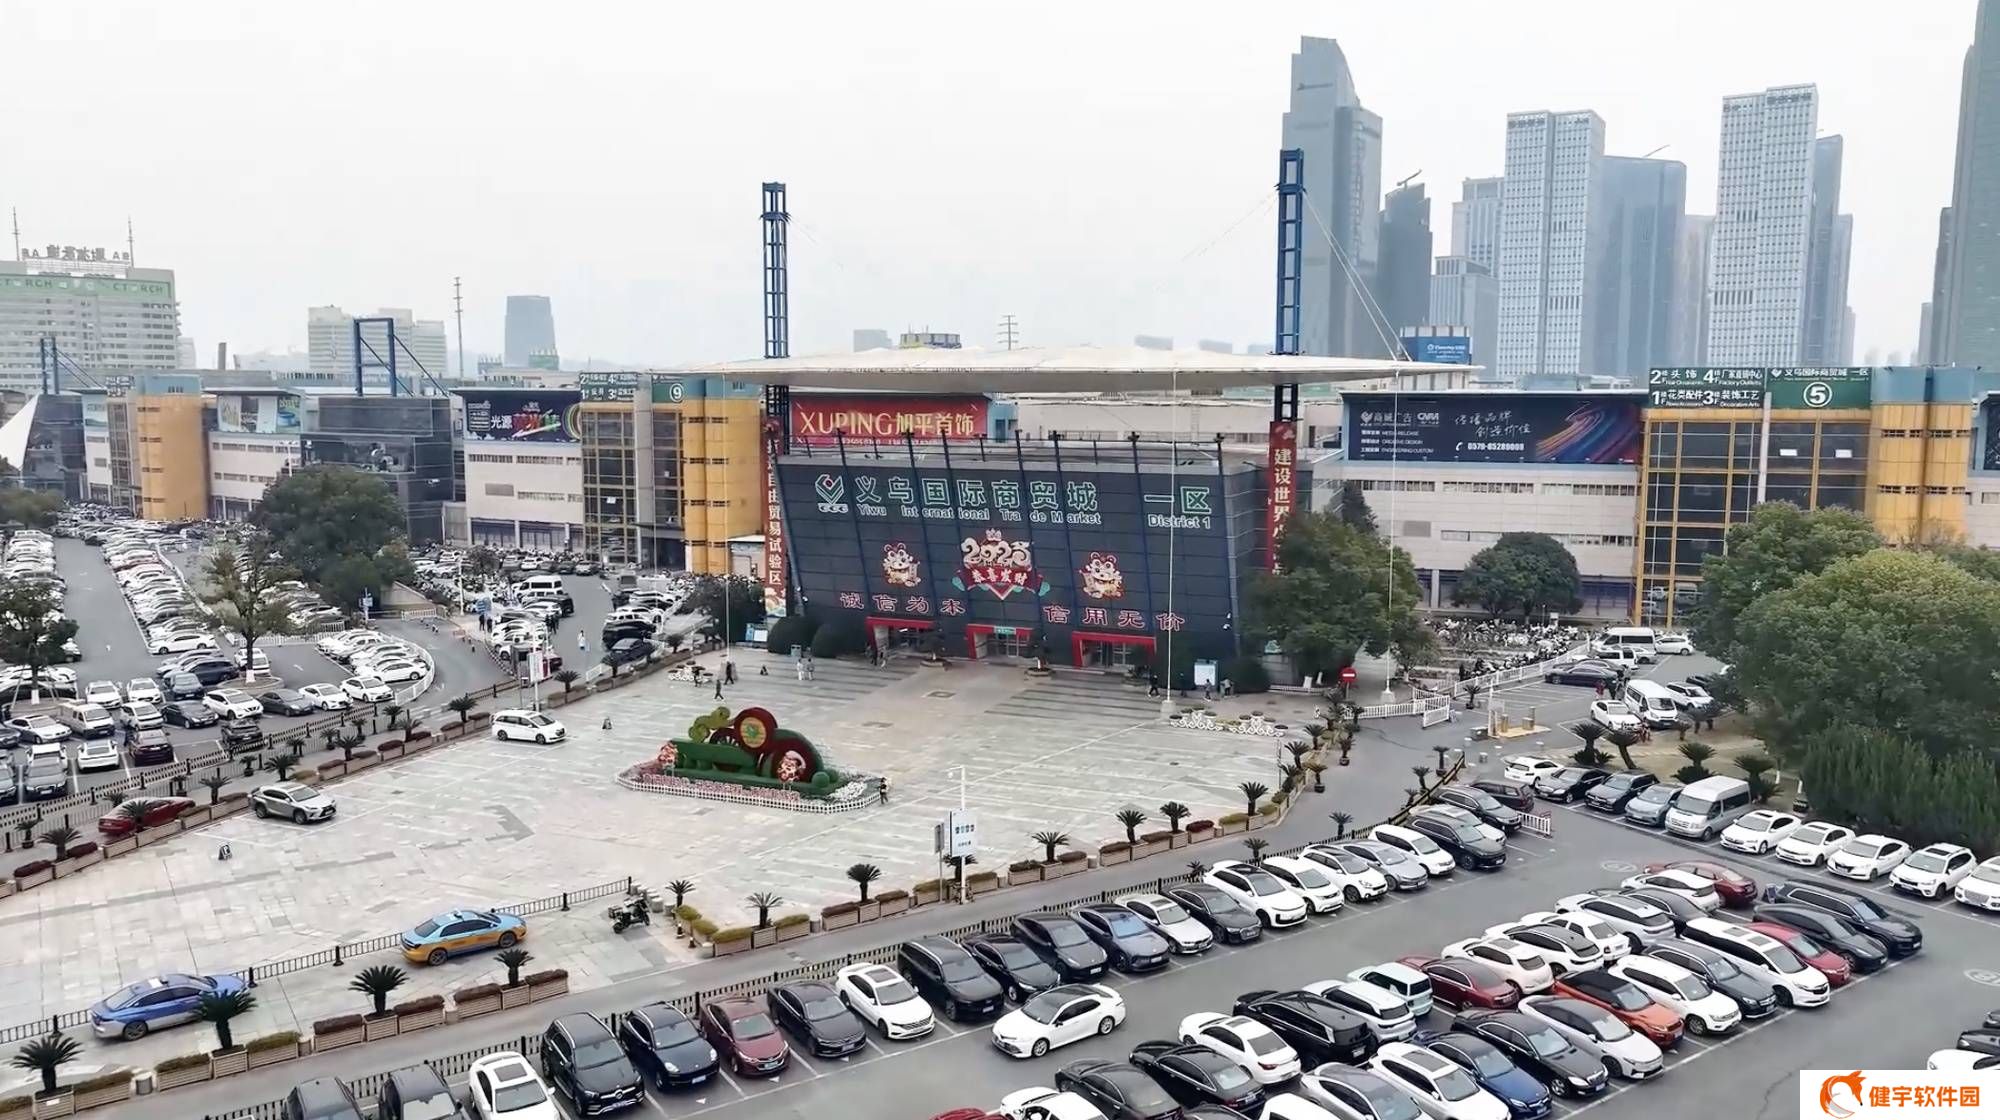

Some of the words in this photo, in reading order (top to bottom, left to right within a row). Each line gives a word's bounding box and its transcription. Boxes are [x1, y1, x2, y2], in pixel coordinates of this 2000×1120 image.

[1650, 369, 1661, 384] 2
[1703, 369, 1714, 384] 4
[673, 386, 682, 399] 9
[1651, 390, 1660, 405] 1
[1702, 390, 1714, 405] 3
[1809, 386, 1826, 404] 5
[800, 411, 892, 436] XUPING
[895, 412, 975, 436] 旭平首饰
[855, 475, 1098, 512] 义乌国际商贸城
[1144, 485, 1212, 515] 一区
[856, 503, 887, 516] Yiwu
[1148, 514, 1200, 528] District
[1202, 516, 1211, 529] 1
[961, 537, 1033, 570] 2025
[839, 592, 967, 616] 诚信为本
